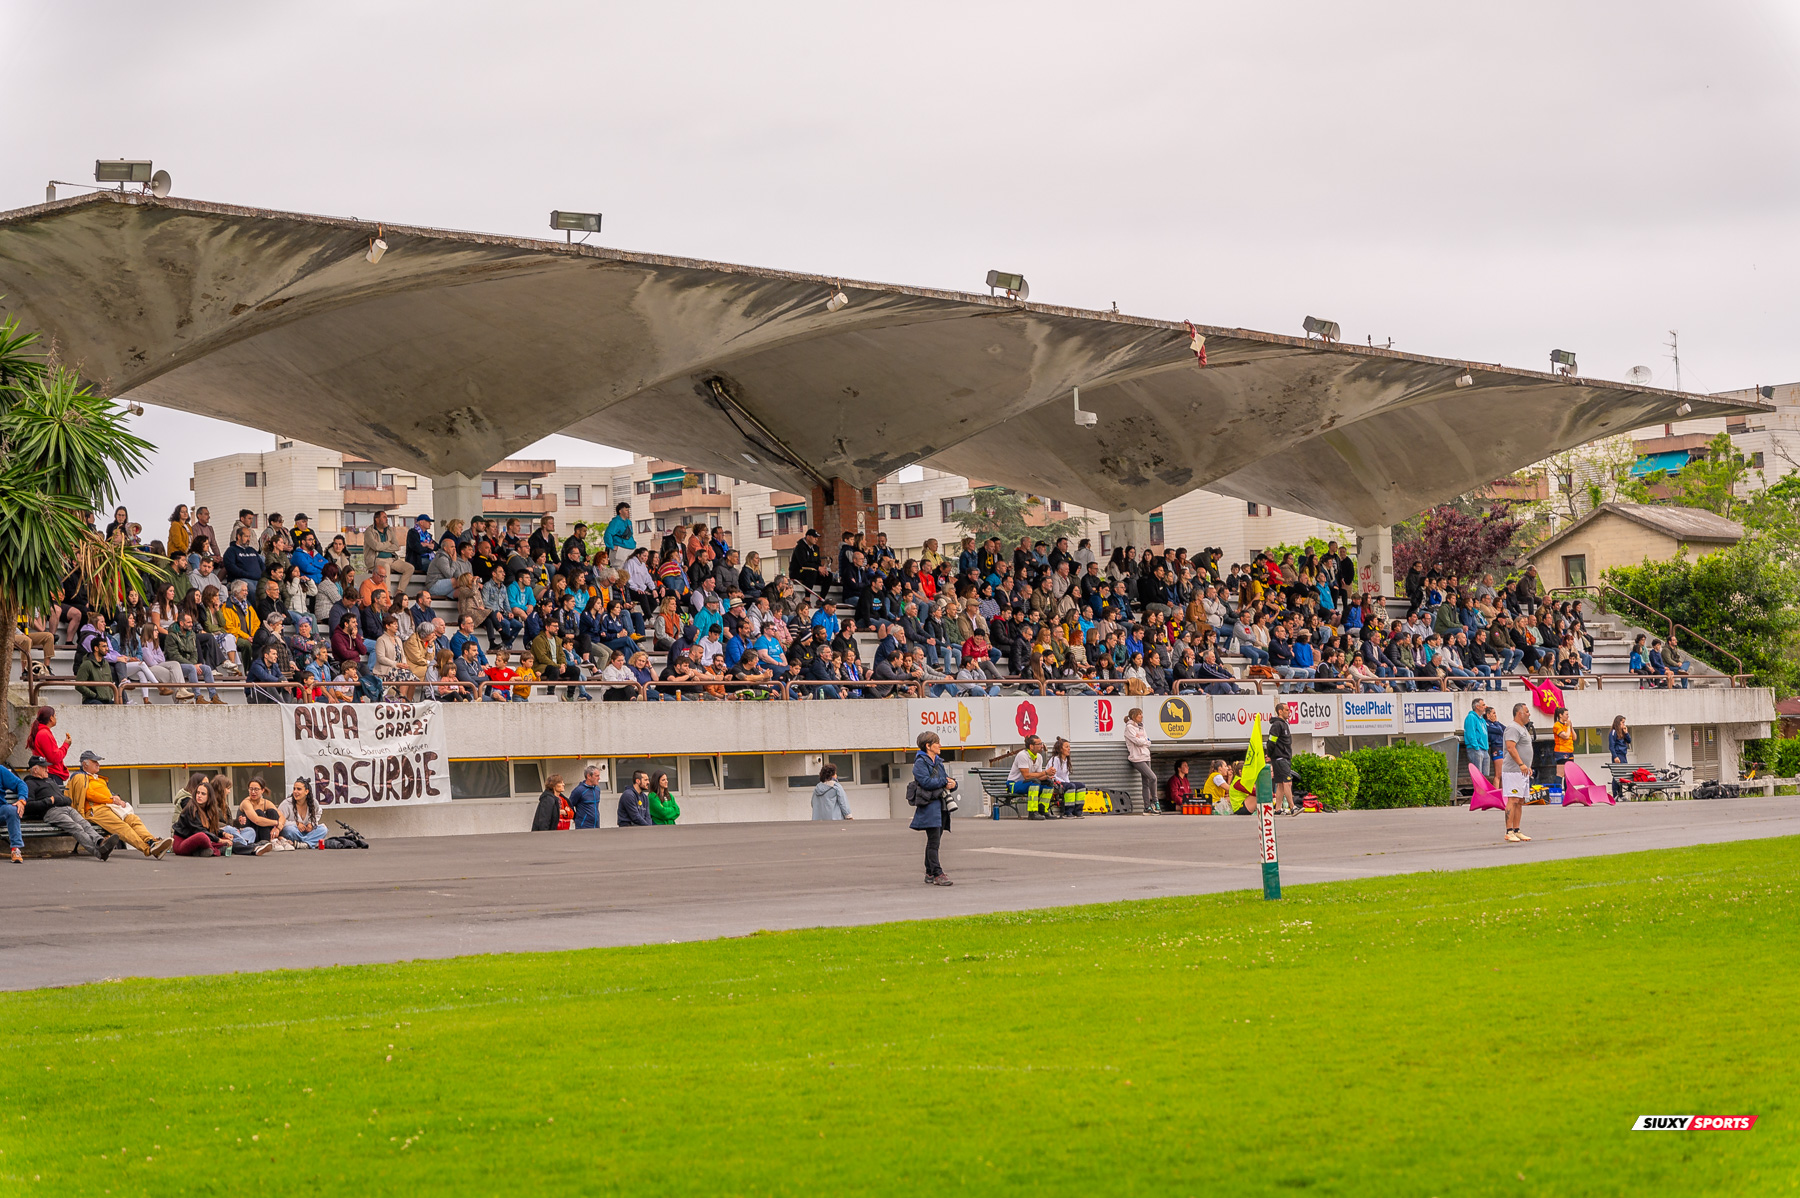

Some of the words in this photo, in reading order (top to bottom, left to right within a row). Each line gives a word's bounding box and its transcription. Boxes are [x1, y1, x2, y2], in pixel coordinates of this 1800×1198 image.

[1300, 701, 1331, 718] Getxo
[1345, 701, 1392, 716] SteelPhalt
[1416, 705, 1451, 720] SENER
[294, 705, 359, 740] AUPA
[921, 711, 957, 725] SOLAR
[1214, 712, 1236, 722] GIROA
[936, 726, 958, 734] PACK
[1167, 723, 1185, 732] Getxo
[1263, 804, 1275, 860] Kantxa
